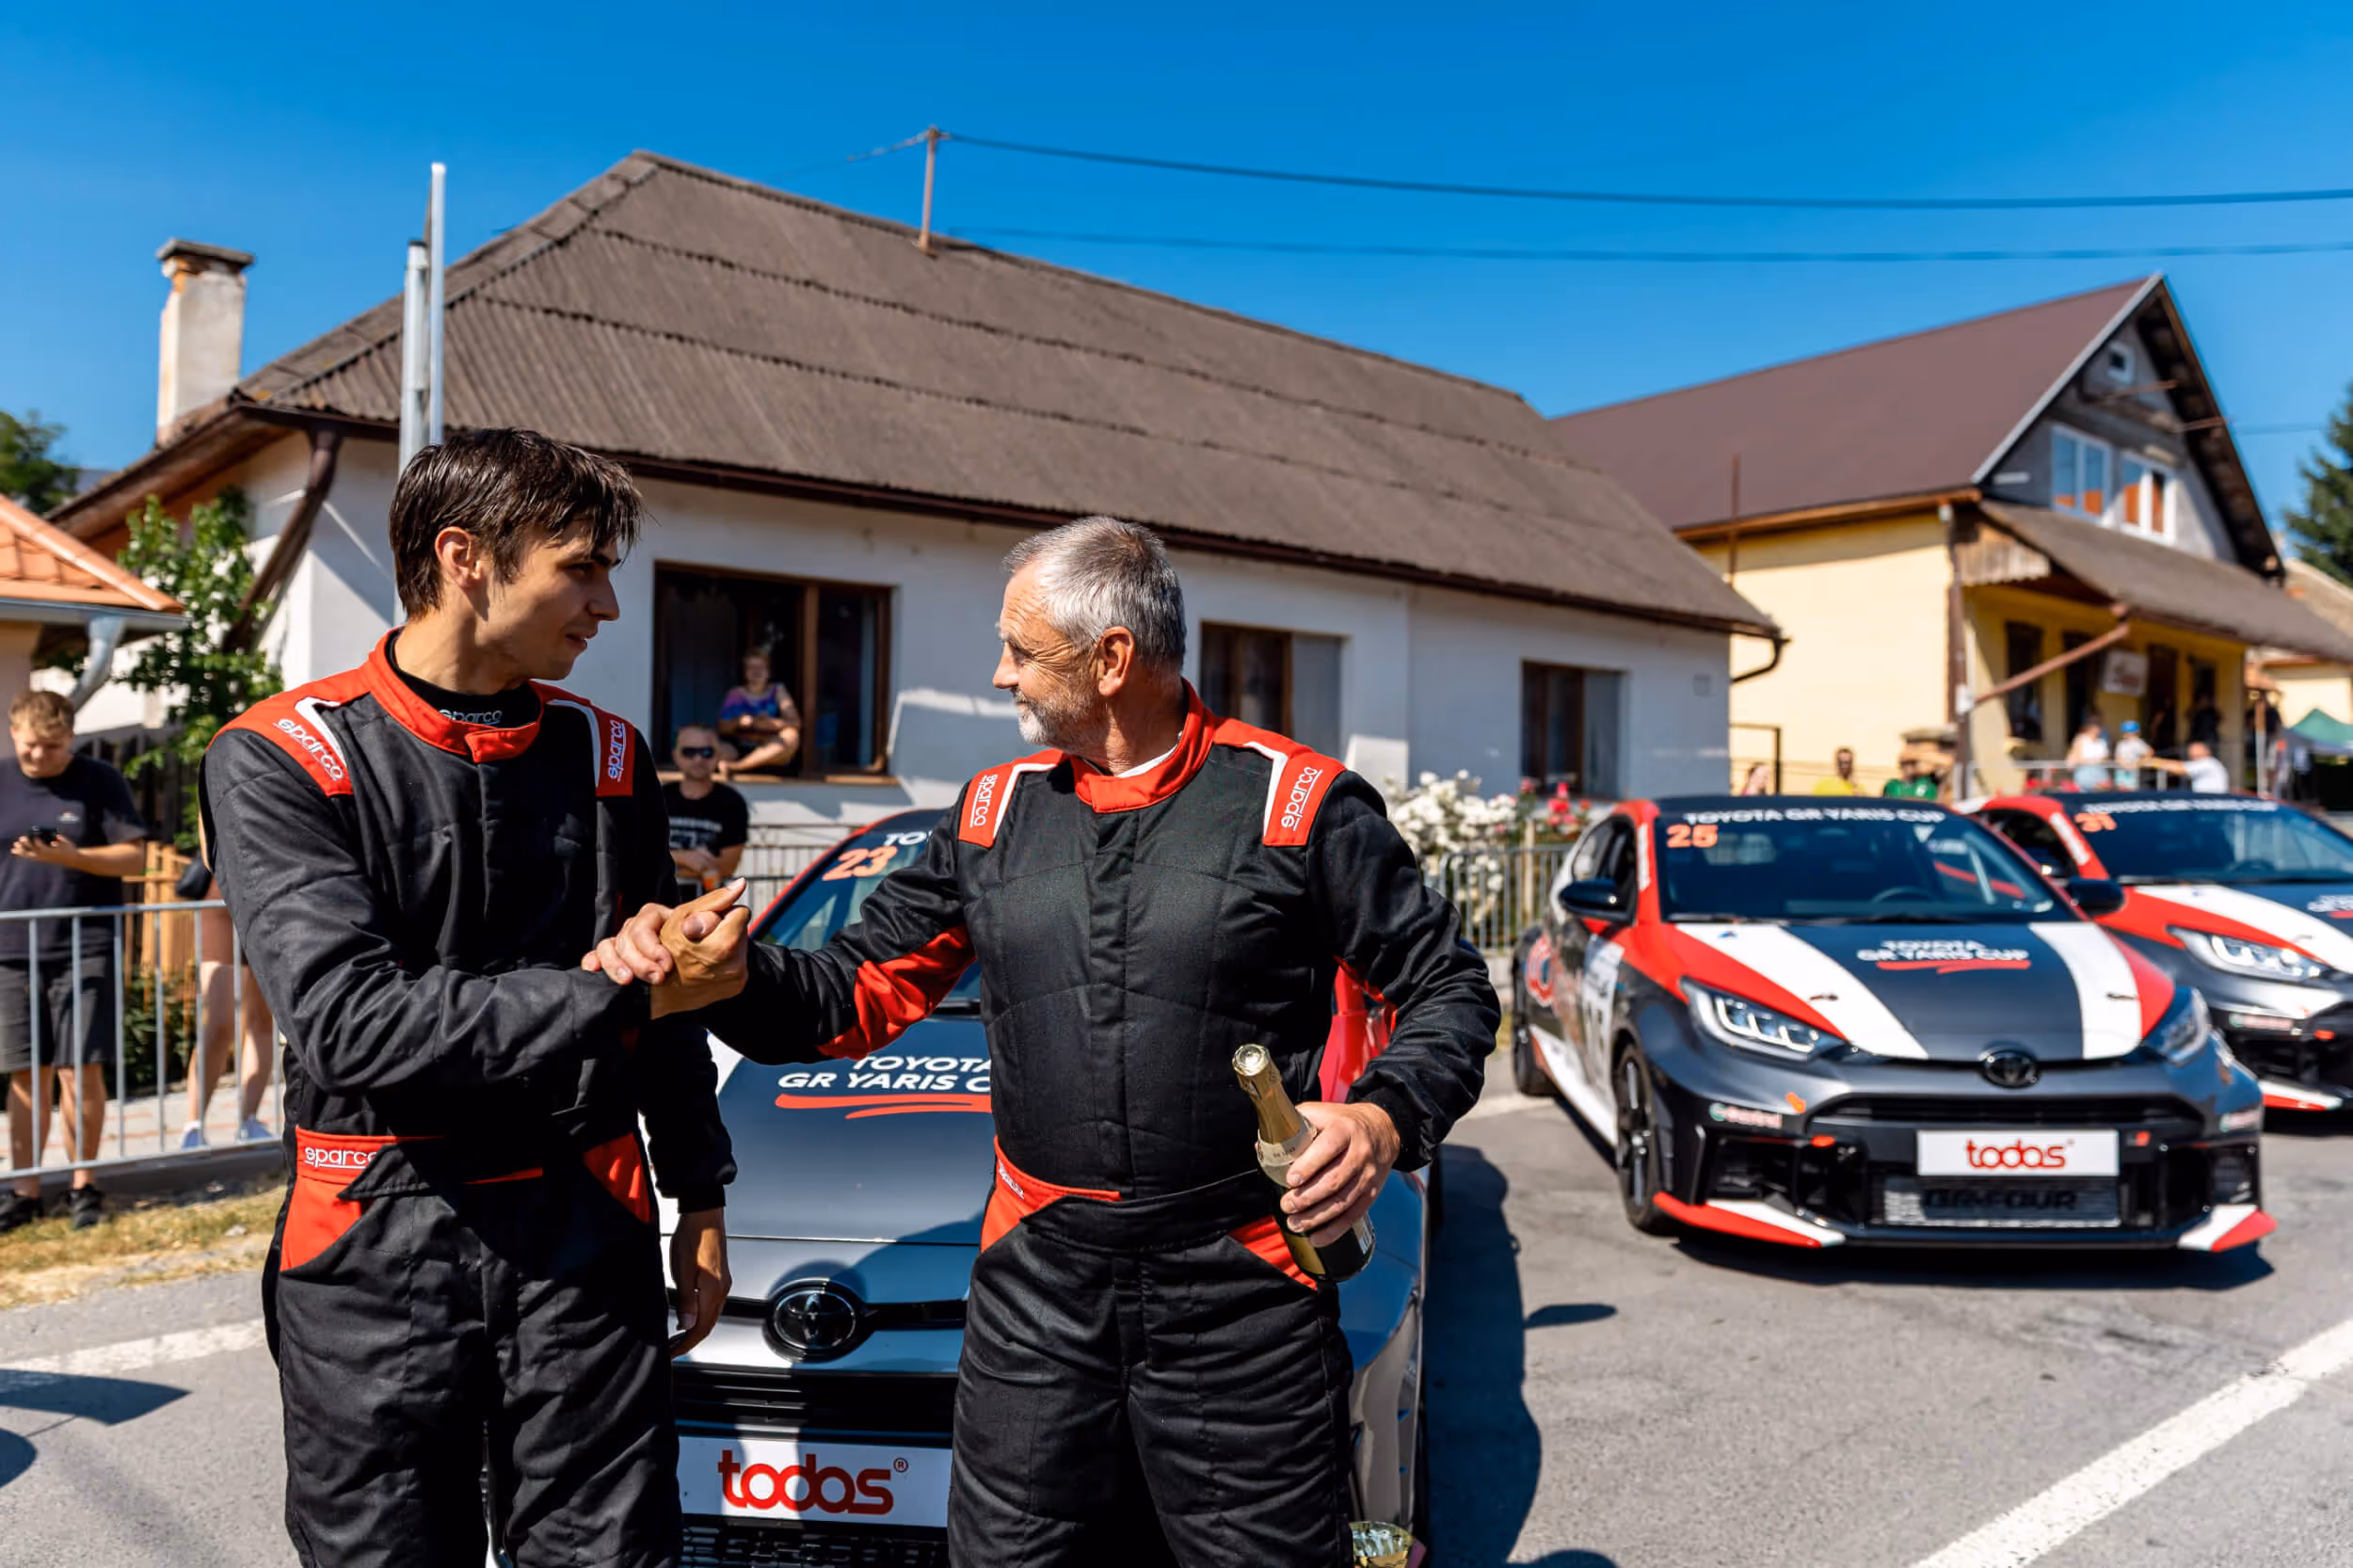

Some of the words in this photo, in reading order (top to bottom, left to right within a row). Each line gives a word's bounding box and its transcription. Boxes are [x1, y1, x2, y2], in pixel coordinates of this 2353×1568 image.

[273, 718, 344, 781] sparco
[608, 719, 626, 782] sparco
[969, 774, 998, 828] sparco
[1281, 767, 1323, 831] sparco
[1666, 824, 1718, 848] 25
[822, 846, 898, 882] 23
[777, 1072, 839, 1089] GR
[847, 1072, 958, 1091] YARIS
[853, 1056, 991, 1073] TOYOTA
